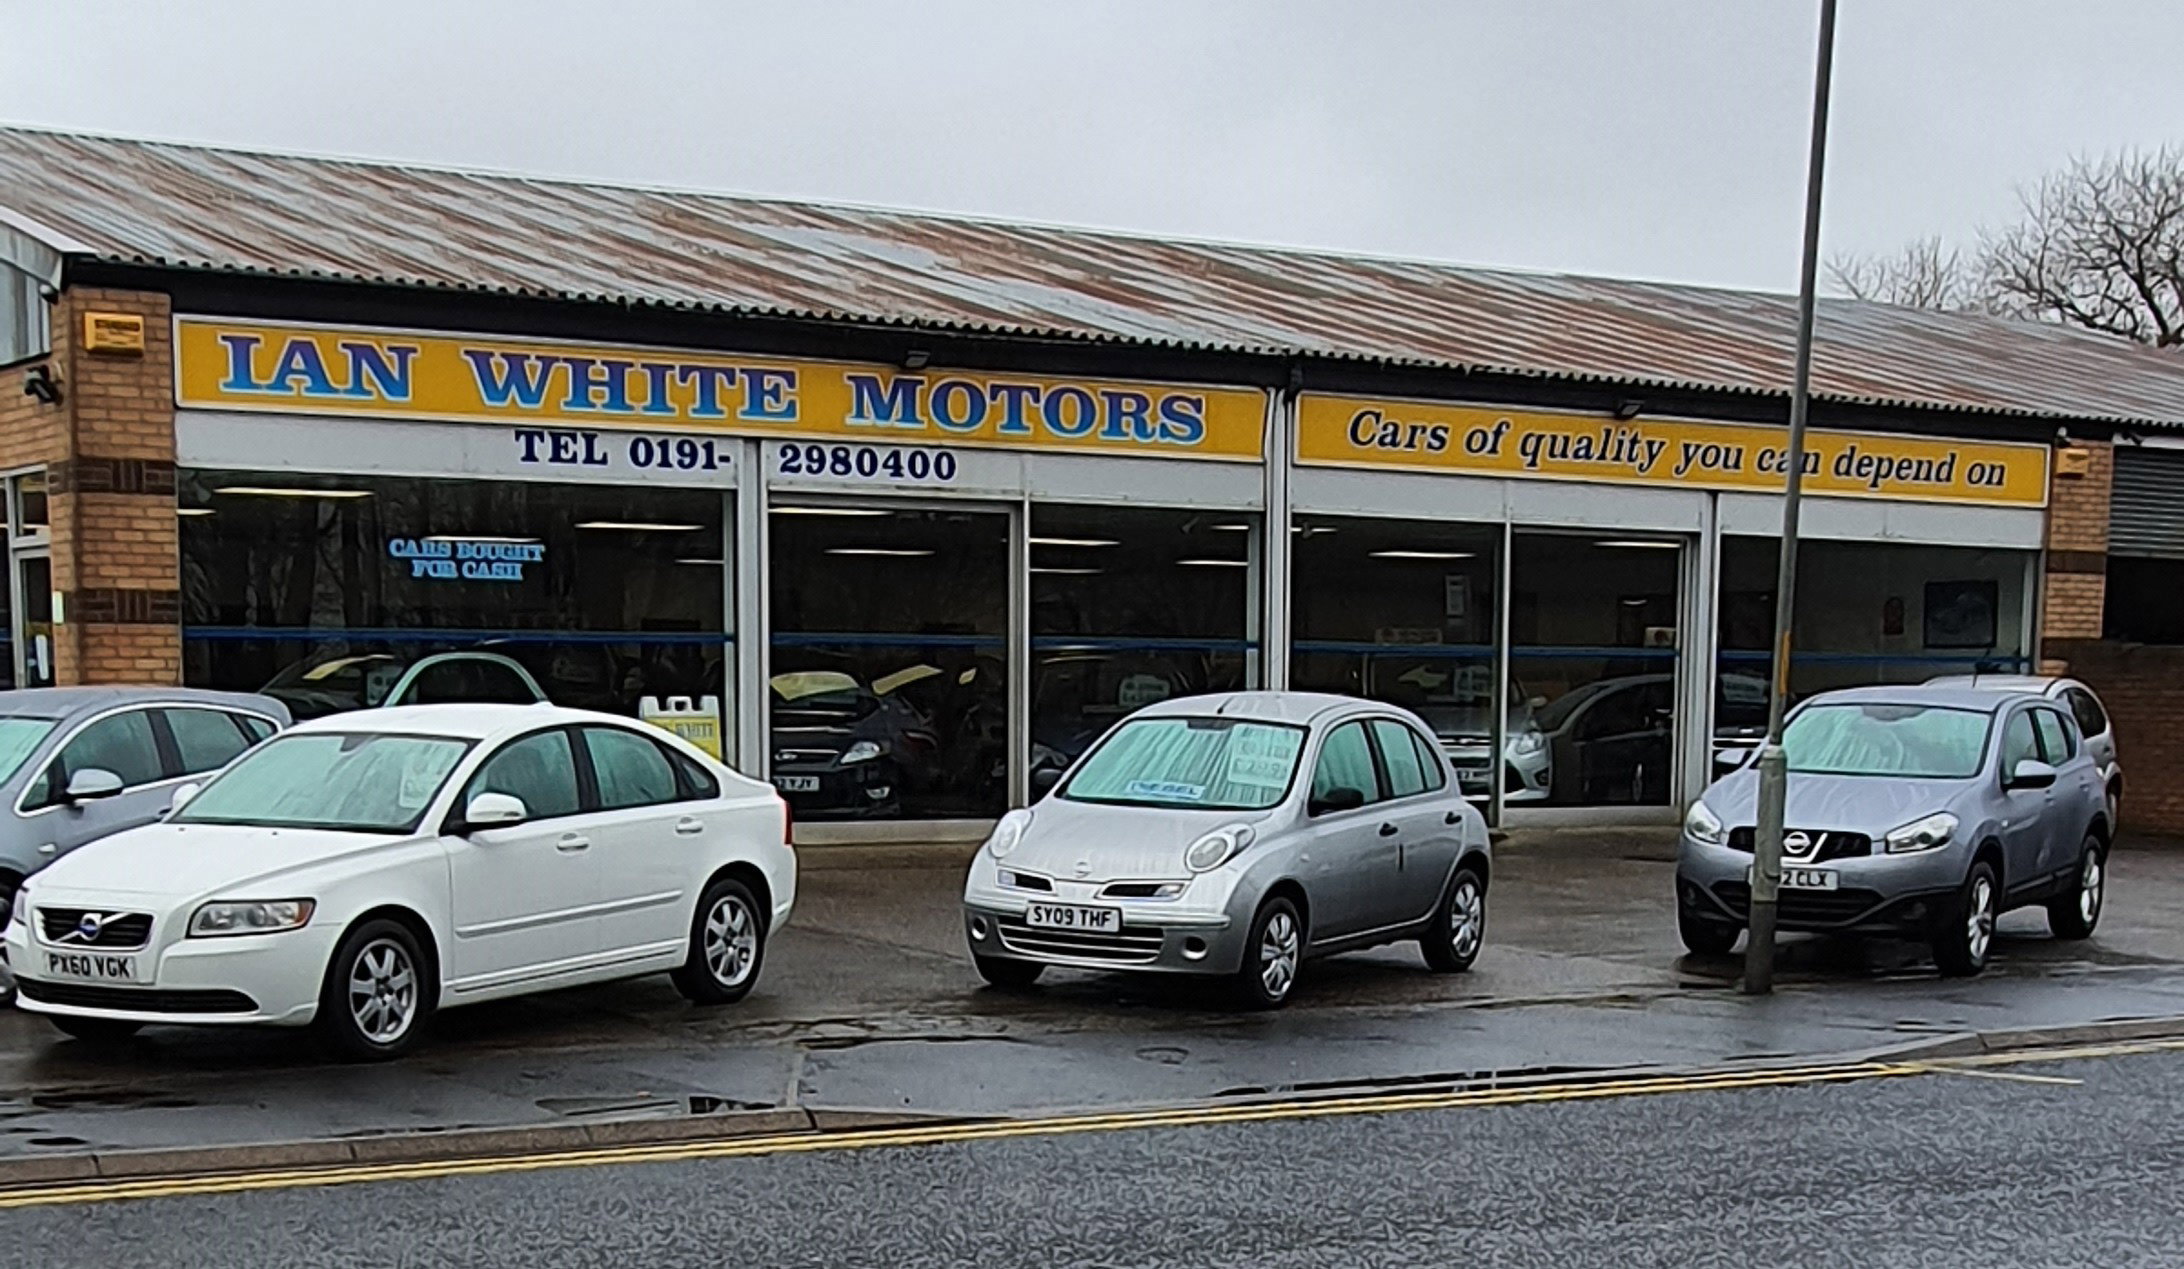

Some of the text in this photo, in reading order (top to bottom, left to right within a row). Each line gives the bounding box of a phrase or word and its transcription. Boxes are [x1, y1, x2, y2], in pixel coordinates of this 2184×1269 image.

[219, 334, 1206, 445] IAN WHITE MOTORS
[514, 430, 957, 481] TEL 0191- 2980400
[1349, 410, 1449, 450] Cars
[1464, 421, 1510, 455] of
[1519, 428, 1667, 473] quality
[1674, 442, 1741, 474] you
[1834, 446, 1957, 489] depend
[1967, 460, 2006, 486] on
[389, 539, 545, 561] CARS BOUGHT
[412, 560, 523, 580] FOR CASH
[1795, 871, 1827, 887] CLX
[1033, 905, 1074, 926] SY09
[95, 955, 130, 978] VGK
